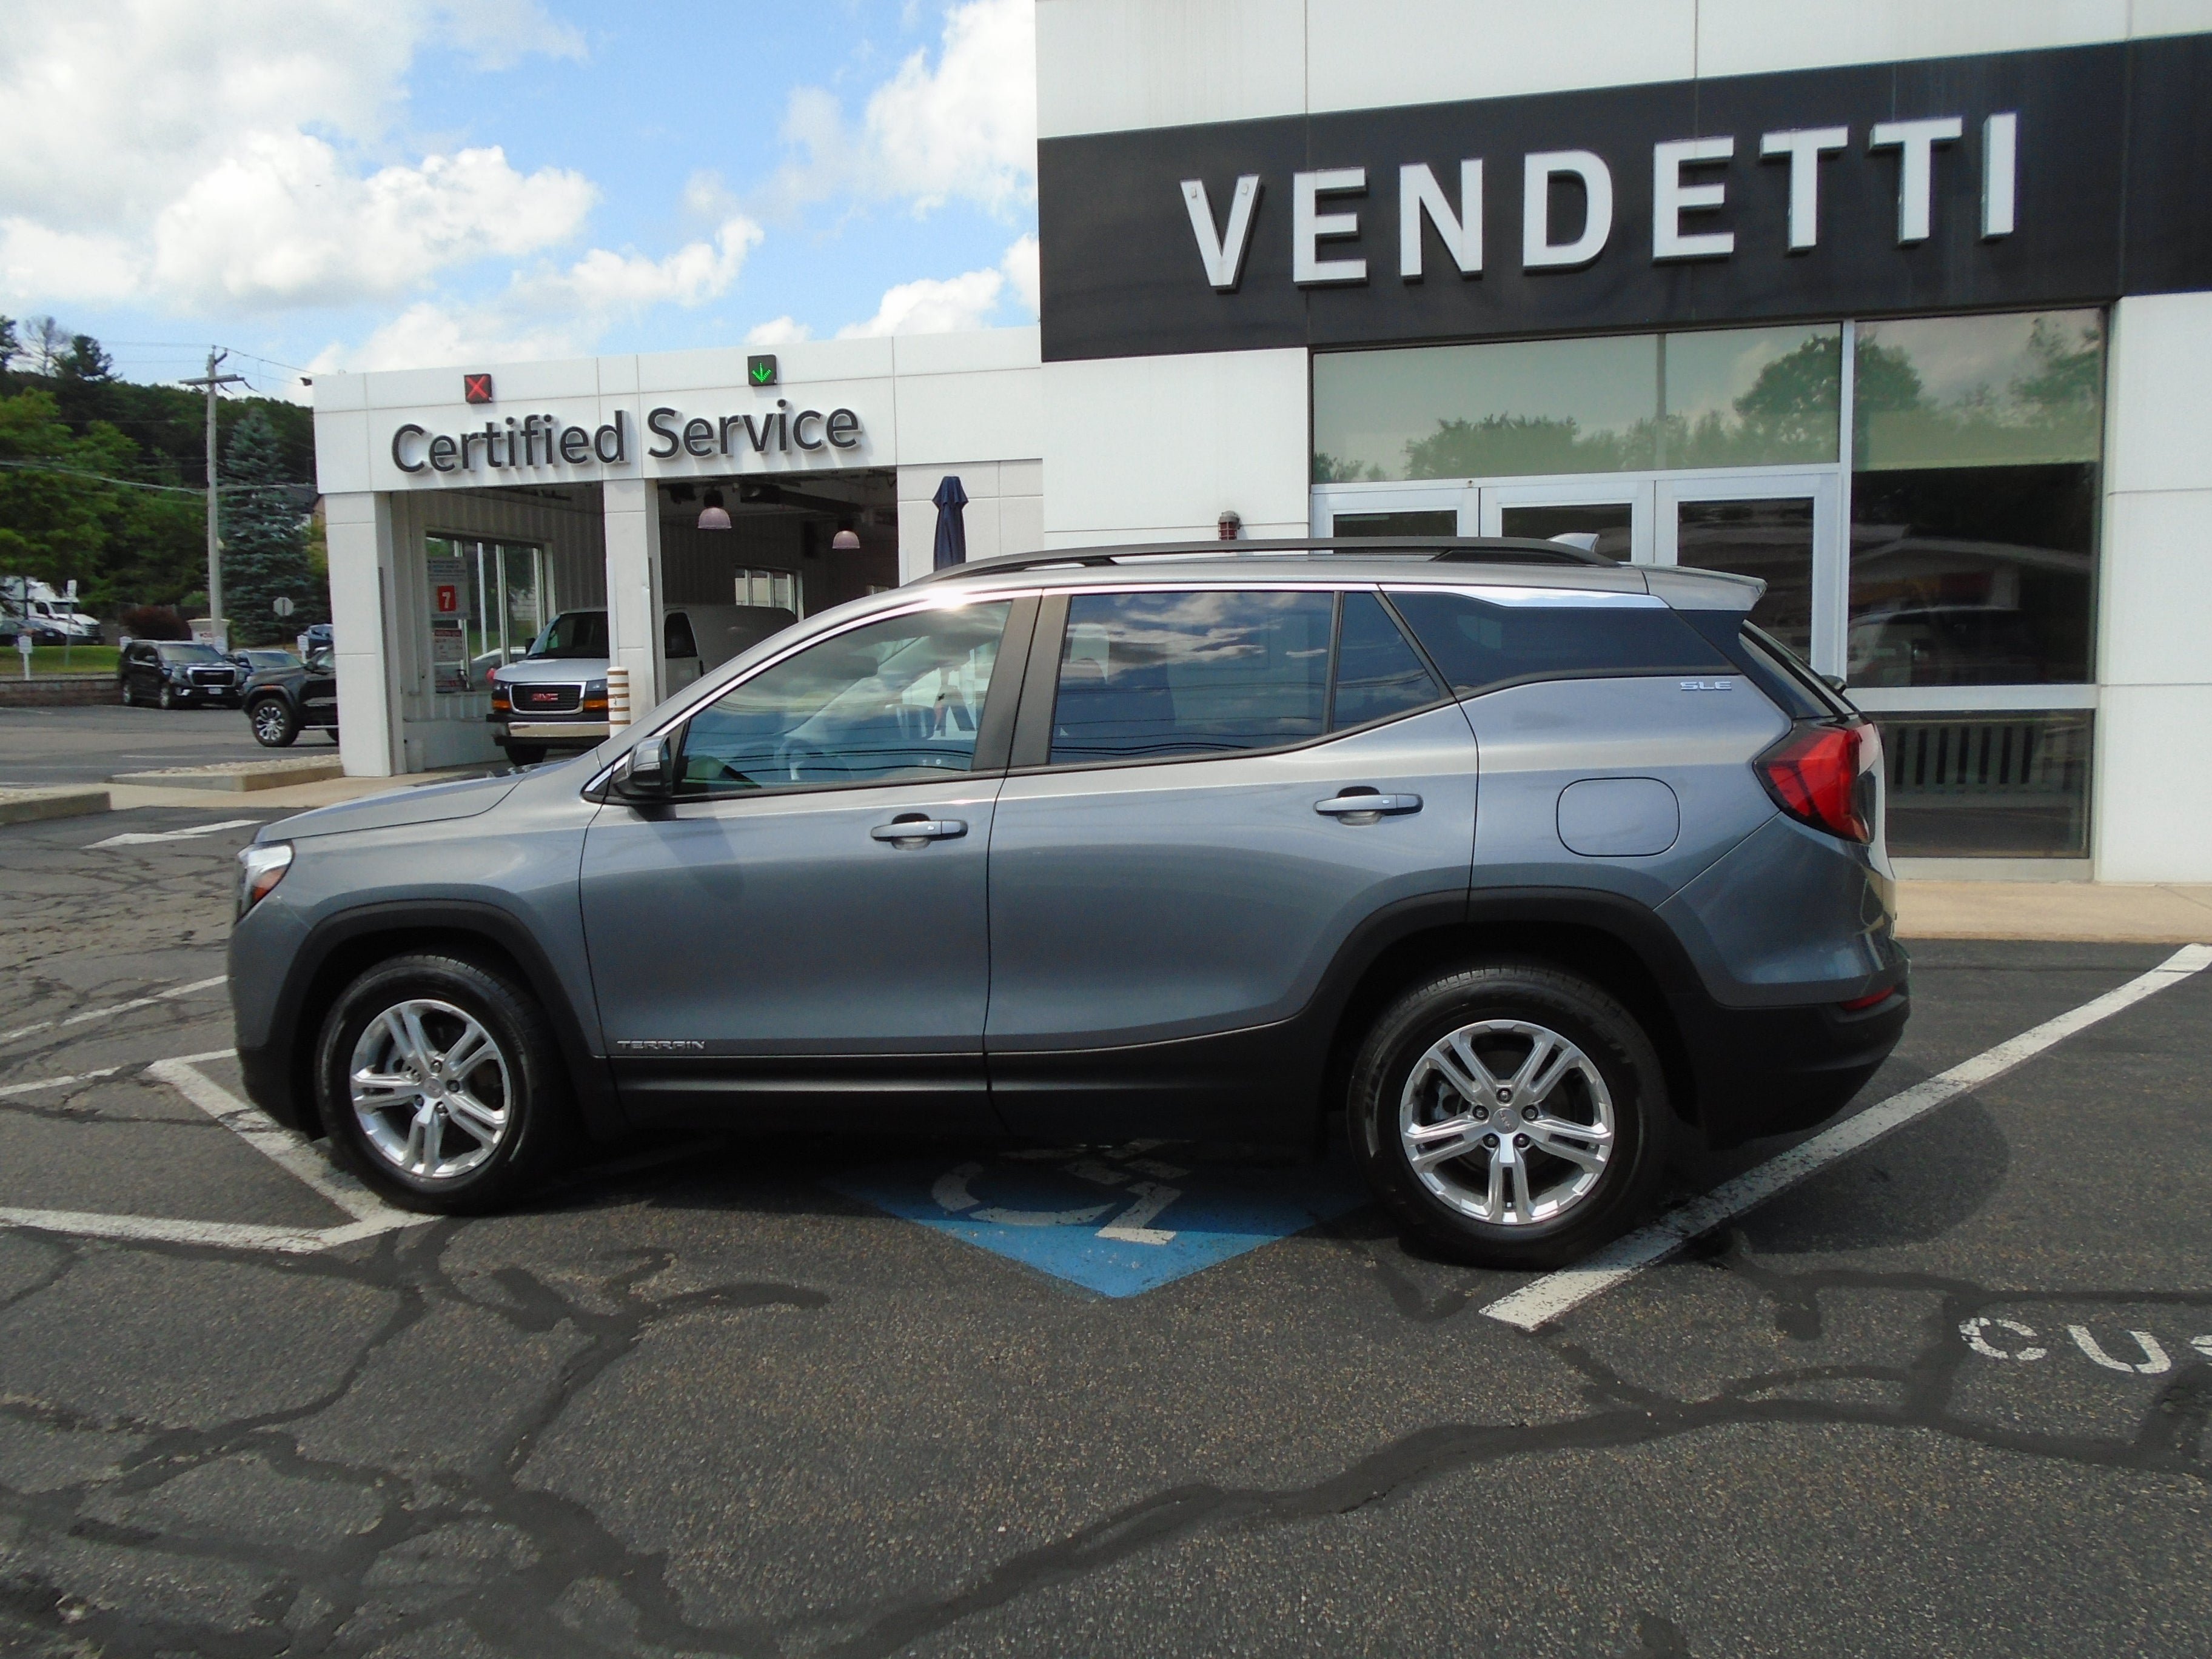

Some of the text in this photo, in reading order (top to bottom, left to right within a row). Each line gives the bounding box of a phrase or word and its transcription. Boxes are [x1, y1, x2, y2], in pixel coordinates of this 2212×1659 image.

[1179, 112, 2017, 290] VENDETTI
[391, 398, 859, 473] Certified Service
[441, 591, 451, 609] 7
[1680, 681, 1732, 691] SLE
[617, 1040, 705, 1050] TERRAIN
